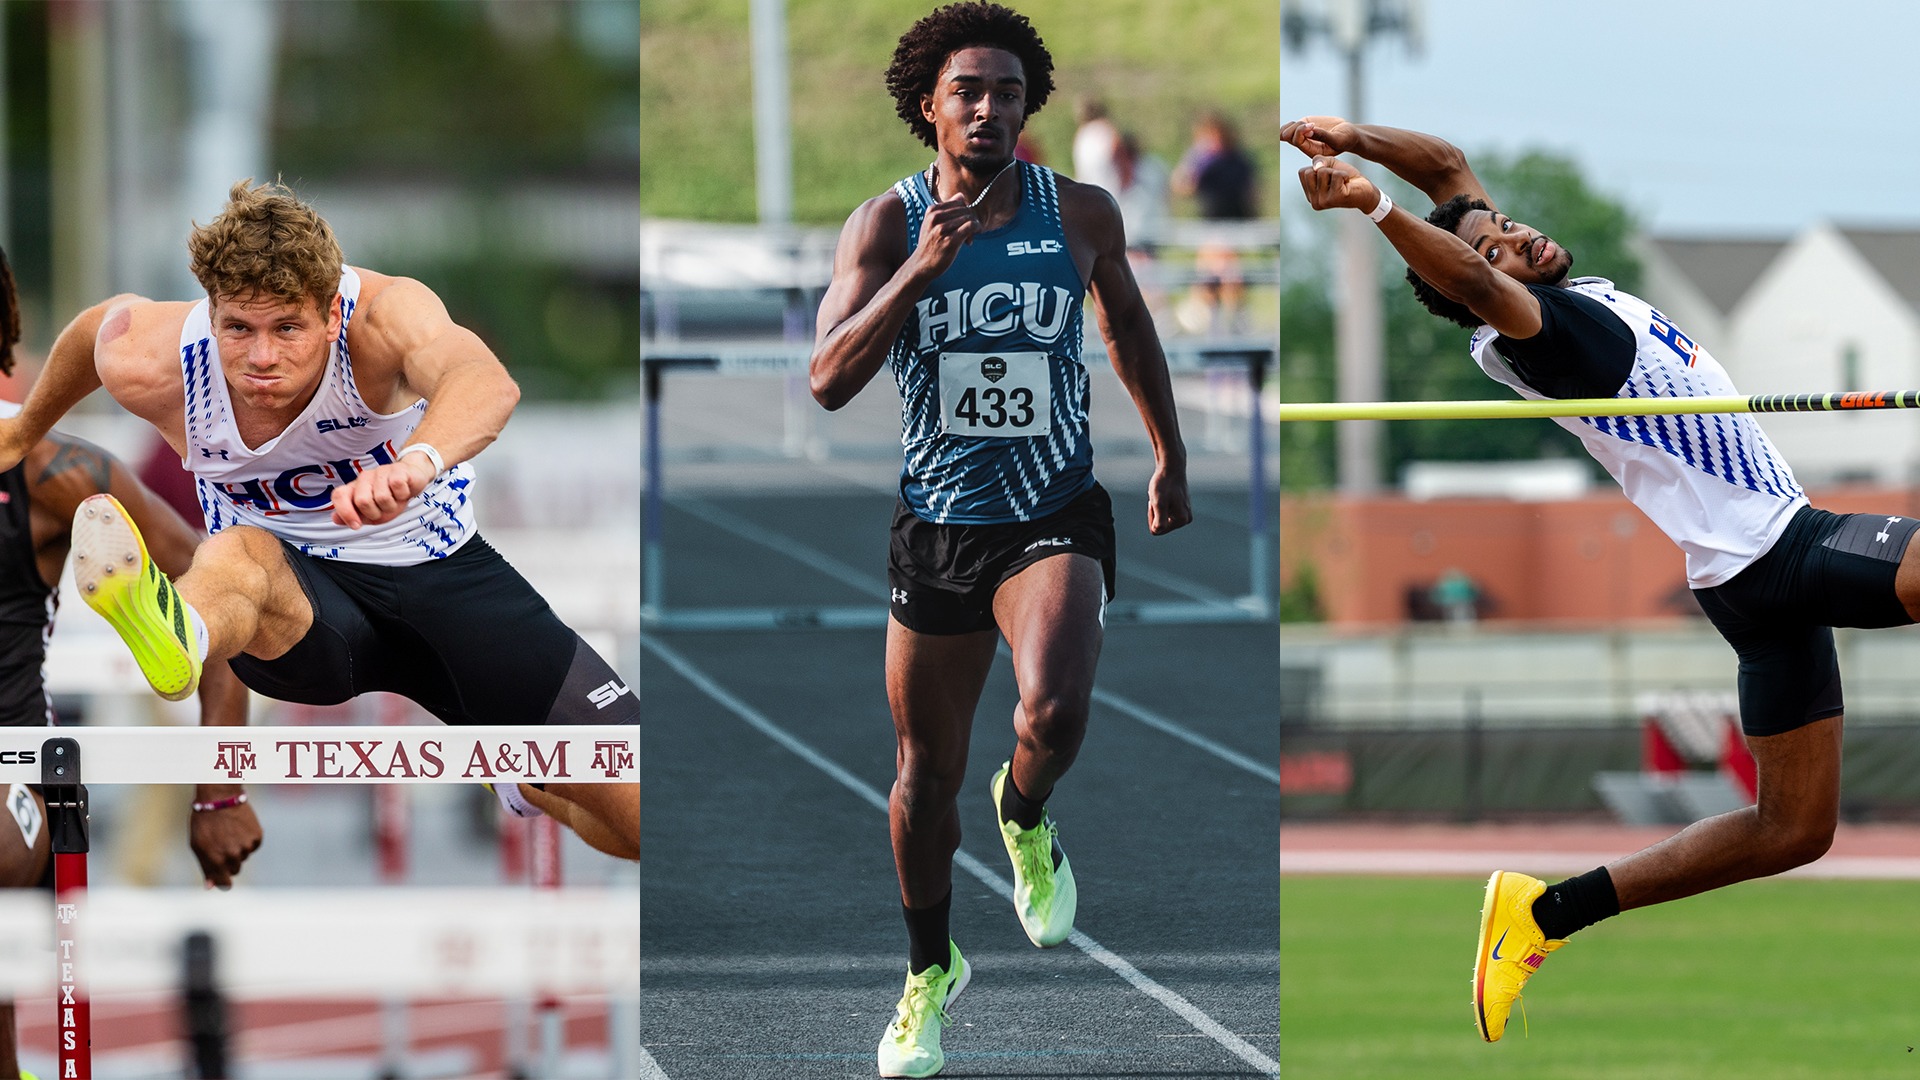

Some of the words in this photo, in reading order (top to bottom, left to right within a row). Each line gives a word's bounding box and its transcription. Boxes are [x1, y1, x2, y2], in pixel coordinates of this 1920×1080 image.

[1006, 239, 1063, 256] SLC
[915, 282, 1074, 355] HCU
[1649, 309, 1699, 369] H
[955, 387, 1034, 428] 433
[1840, 391, 1888, 408] GILL
[586, 679, 630, 710] SL
[276, 740, 445, 778] TEXAS
[461, 740, 571, 778] A&M
[60, 940, 76, 1050] TEXAS
[64, 1059, 78, 1079] A
